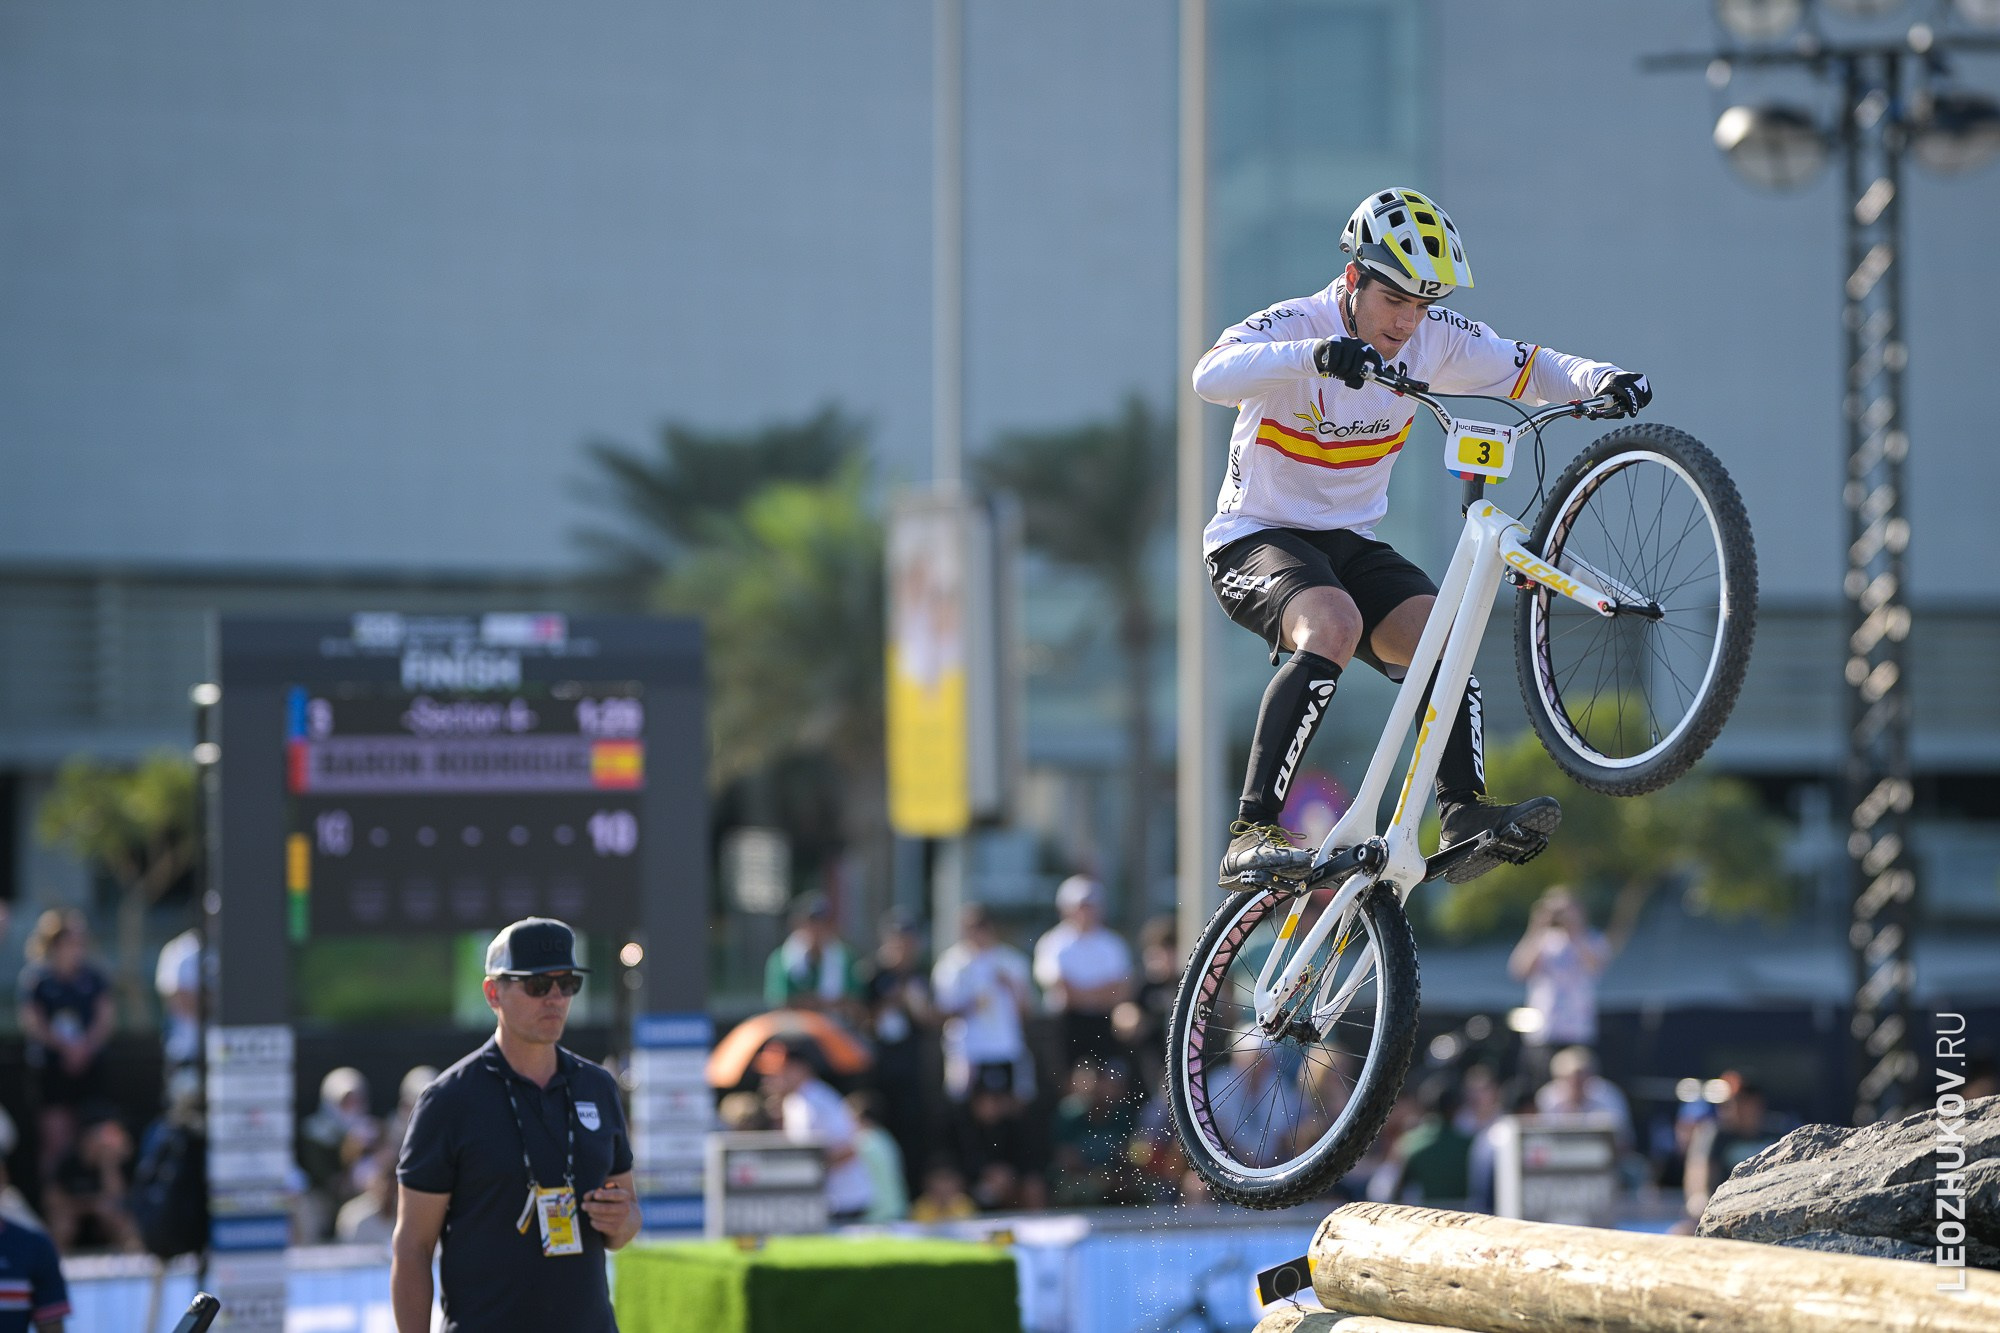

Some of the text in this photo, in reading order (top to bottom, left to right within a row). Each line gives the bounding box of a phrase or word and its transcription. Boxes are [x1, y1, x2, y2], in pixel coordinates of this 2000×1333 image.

[1427, 309, 1481, 338] ofidis
[1318, 419, 1390, 438] Cofidis
[1436, 405, 1452, 426] CLEA
[1476, 441, 1490, 465] 3
[1505, 551, 1580, 597] CLEAN
[1274, 701, 1319, 801] CLEAN
[1468, 693, 1485, 784] CLEAN
